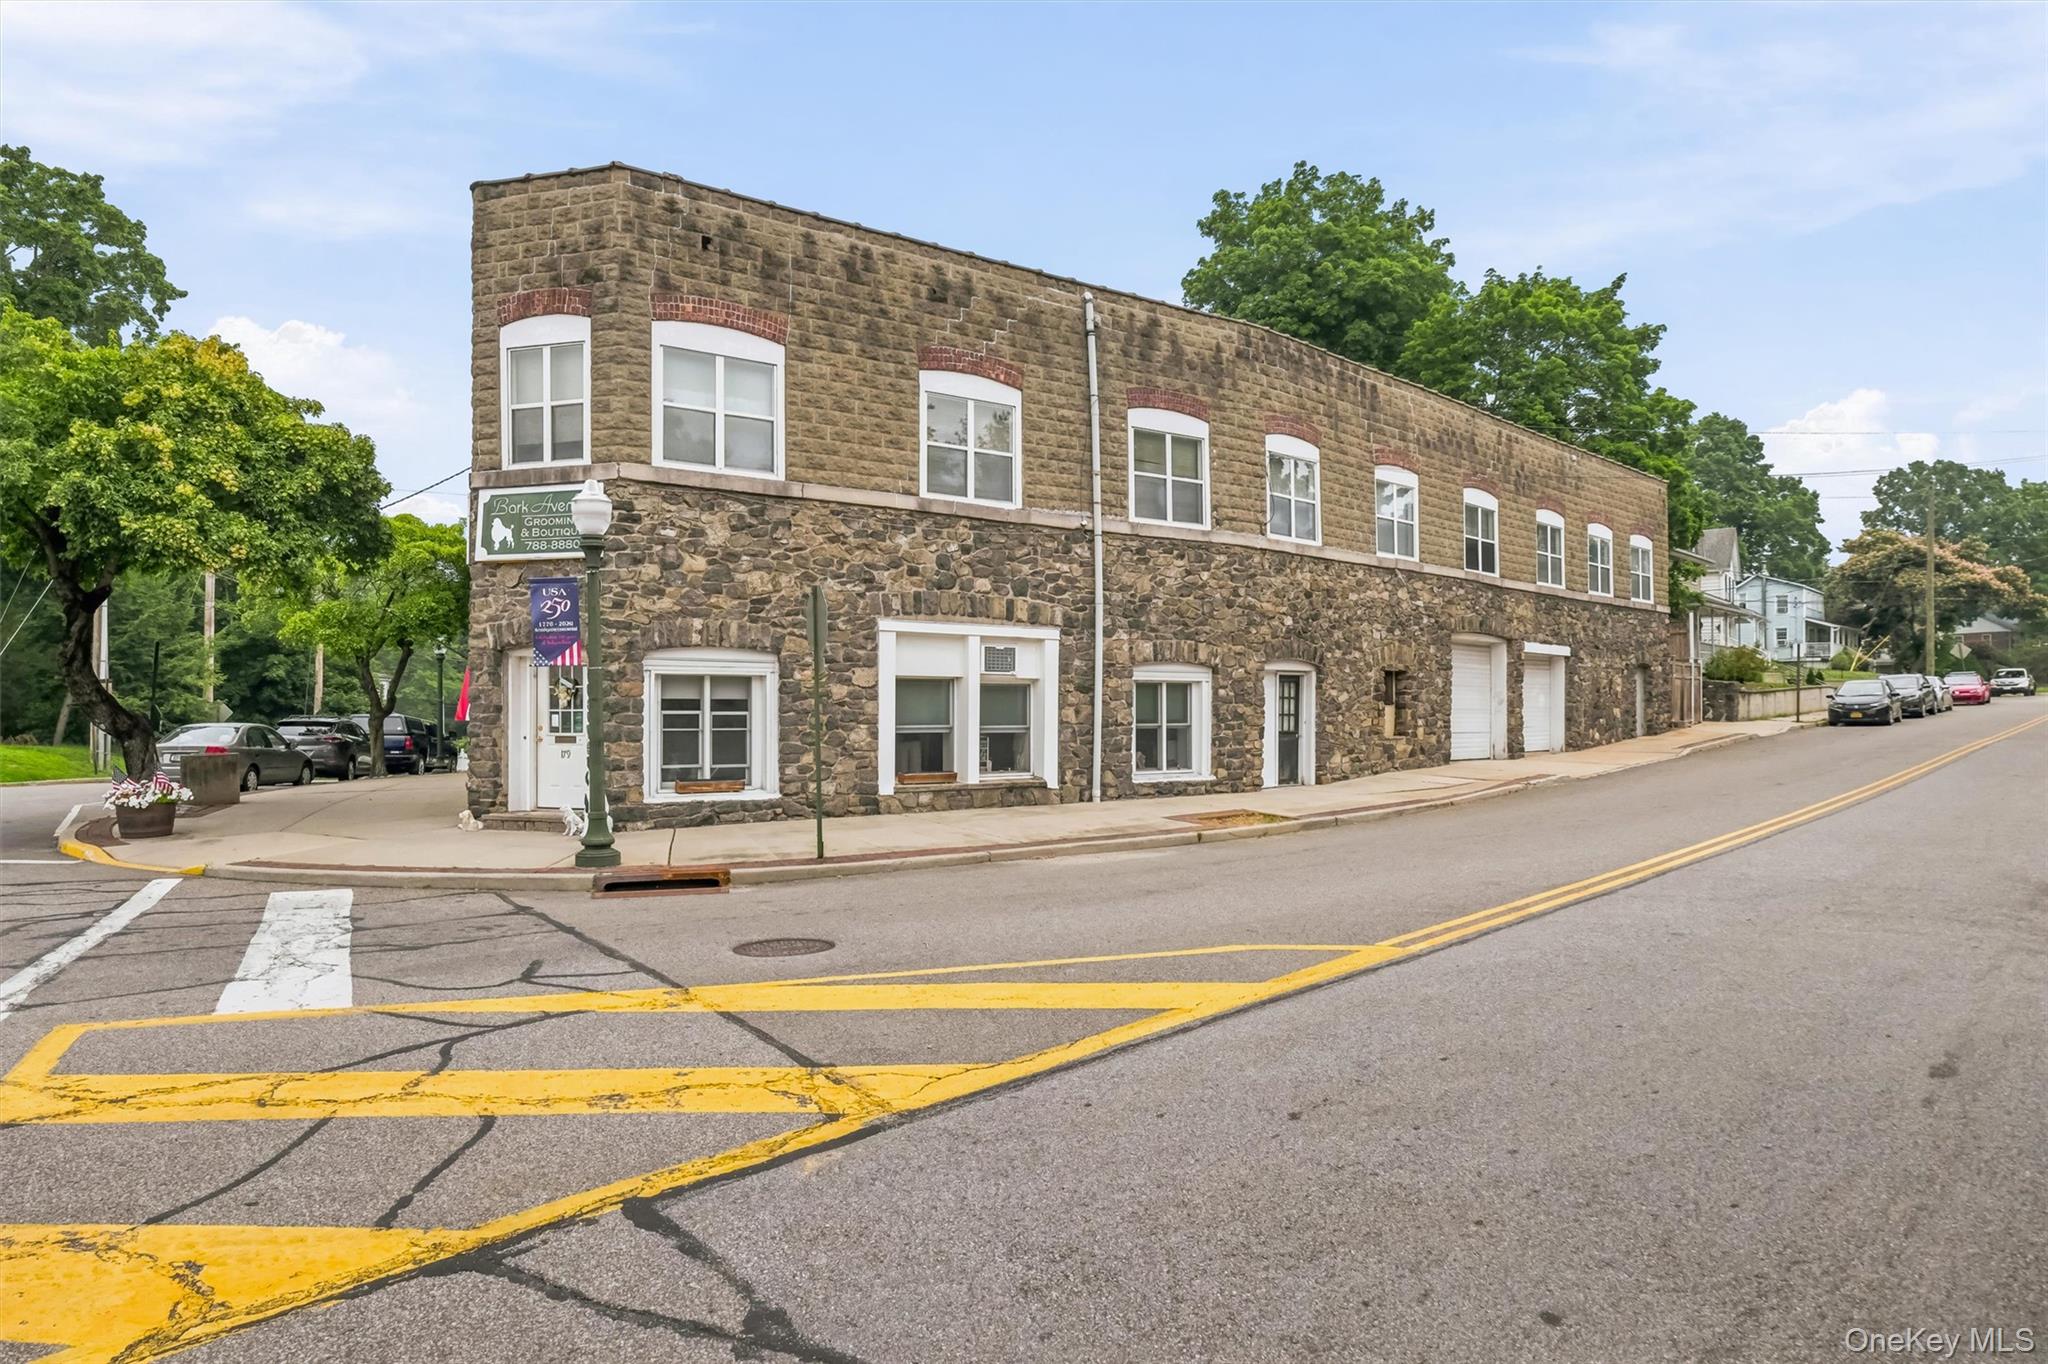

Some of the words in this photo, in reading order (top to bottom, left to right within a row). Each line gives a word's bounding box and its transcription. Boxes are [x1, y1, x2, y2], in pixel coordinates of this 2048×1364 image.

[490, 497, 529, 515] Bark
[531, 493, 574, 514] Aven
[524, 516, 575, 527] GROOMIN
[520, 528, 530, 538] &
[532, 527, 580, 538] BOUTIQU
[525, 539, 581, 551] 788-8880
[542, 587, 567, 597] USA
[540, 597, 571, 620] 250
